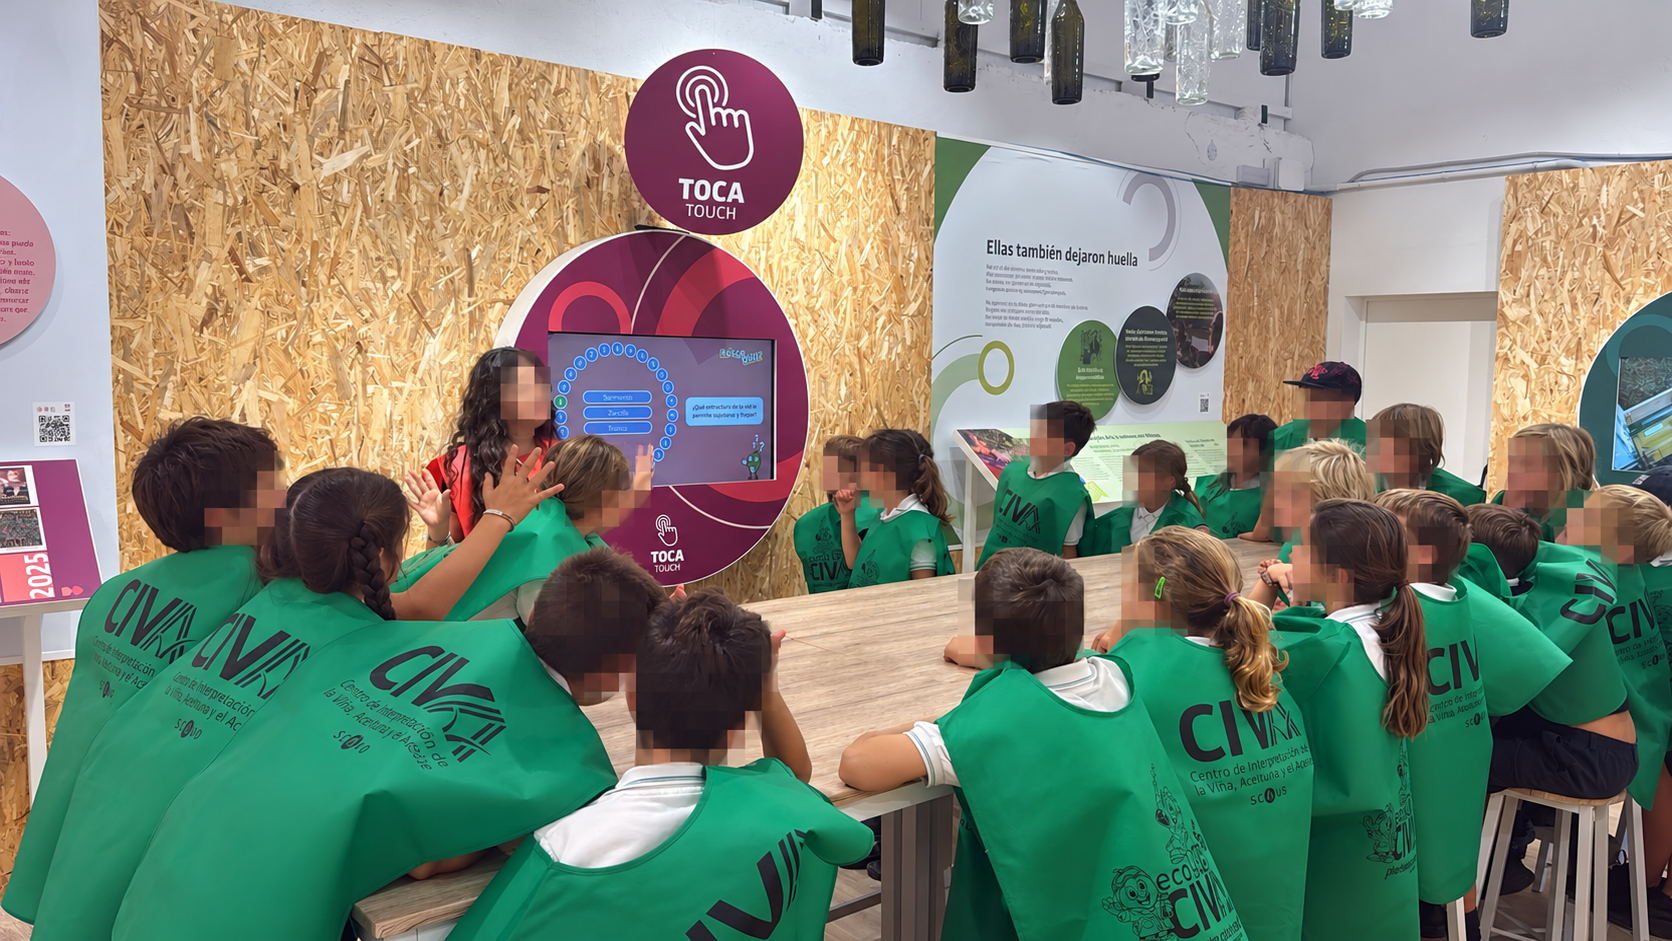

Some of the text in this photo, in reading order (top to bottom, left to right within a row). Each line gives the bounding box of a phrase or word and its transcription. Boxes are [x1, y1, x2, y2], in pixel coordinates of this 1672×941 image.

[678, 178, 745, 204] TOCA
[685, 203, 737, 220] TOUCH
[986, 239, 1138, 267] Ellas también dejaron huella
[650, 549, 685, 563] TOCA
[23, 552, 56, 600] 2025
[654, 563, 681, 573] TOUCH
[1427, 633, 1480, 696] CIV
[1190, 768, 1231, 783] Centro
[1233, 763, 1246, 776] de
[1194, 784, 1207, 797] la
